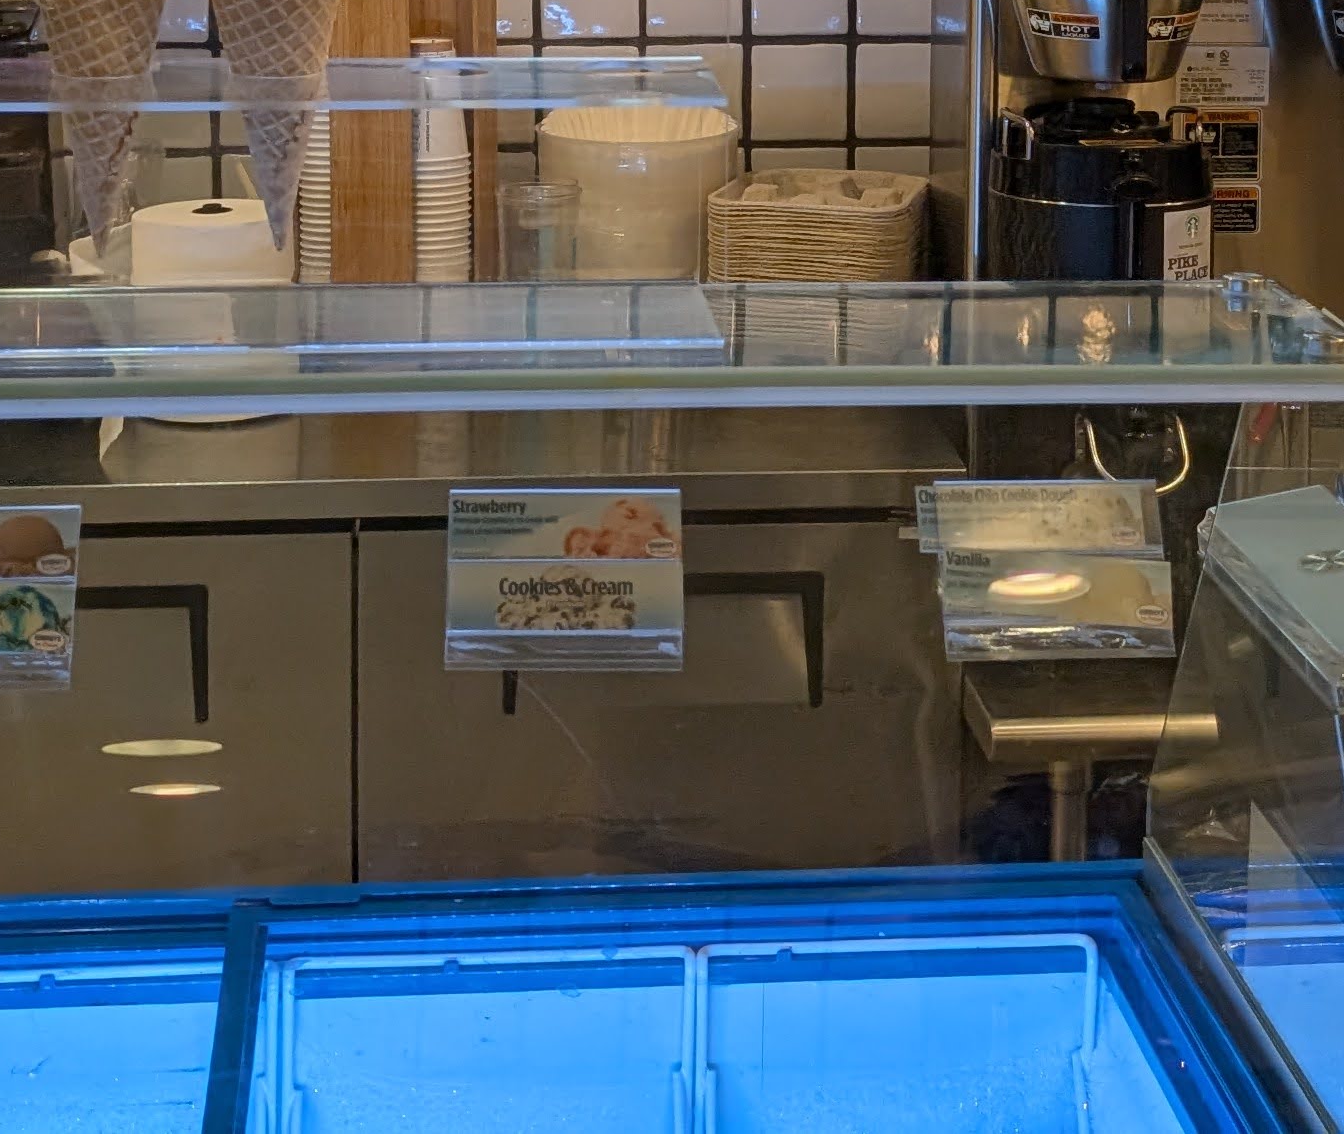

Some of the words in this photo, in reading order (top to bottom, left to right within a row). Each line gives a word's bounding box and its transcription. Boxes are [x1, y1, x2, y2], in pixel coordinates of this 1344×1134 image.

[1060, 24, 1091, 34] HOT
[1167, 254, 1199, 271] PIKE
[452, 498, 527, 516] Strawberry
[945, 550, 991, 568] Vanilla
[498, 577, 562, 597] Cookies
[564, 577, 582, 597] &
[582, 577, 635, 597] Cream
